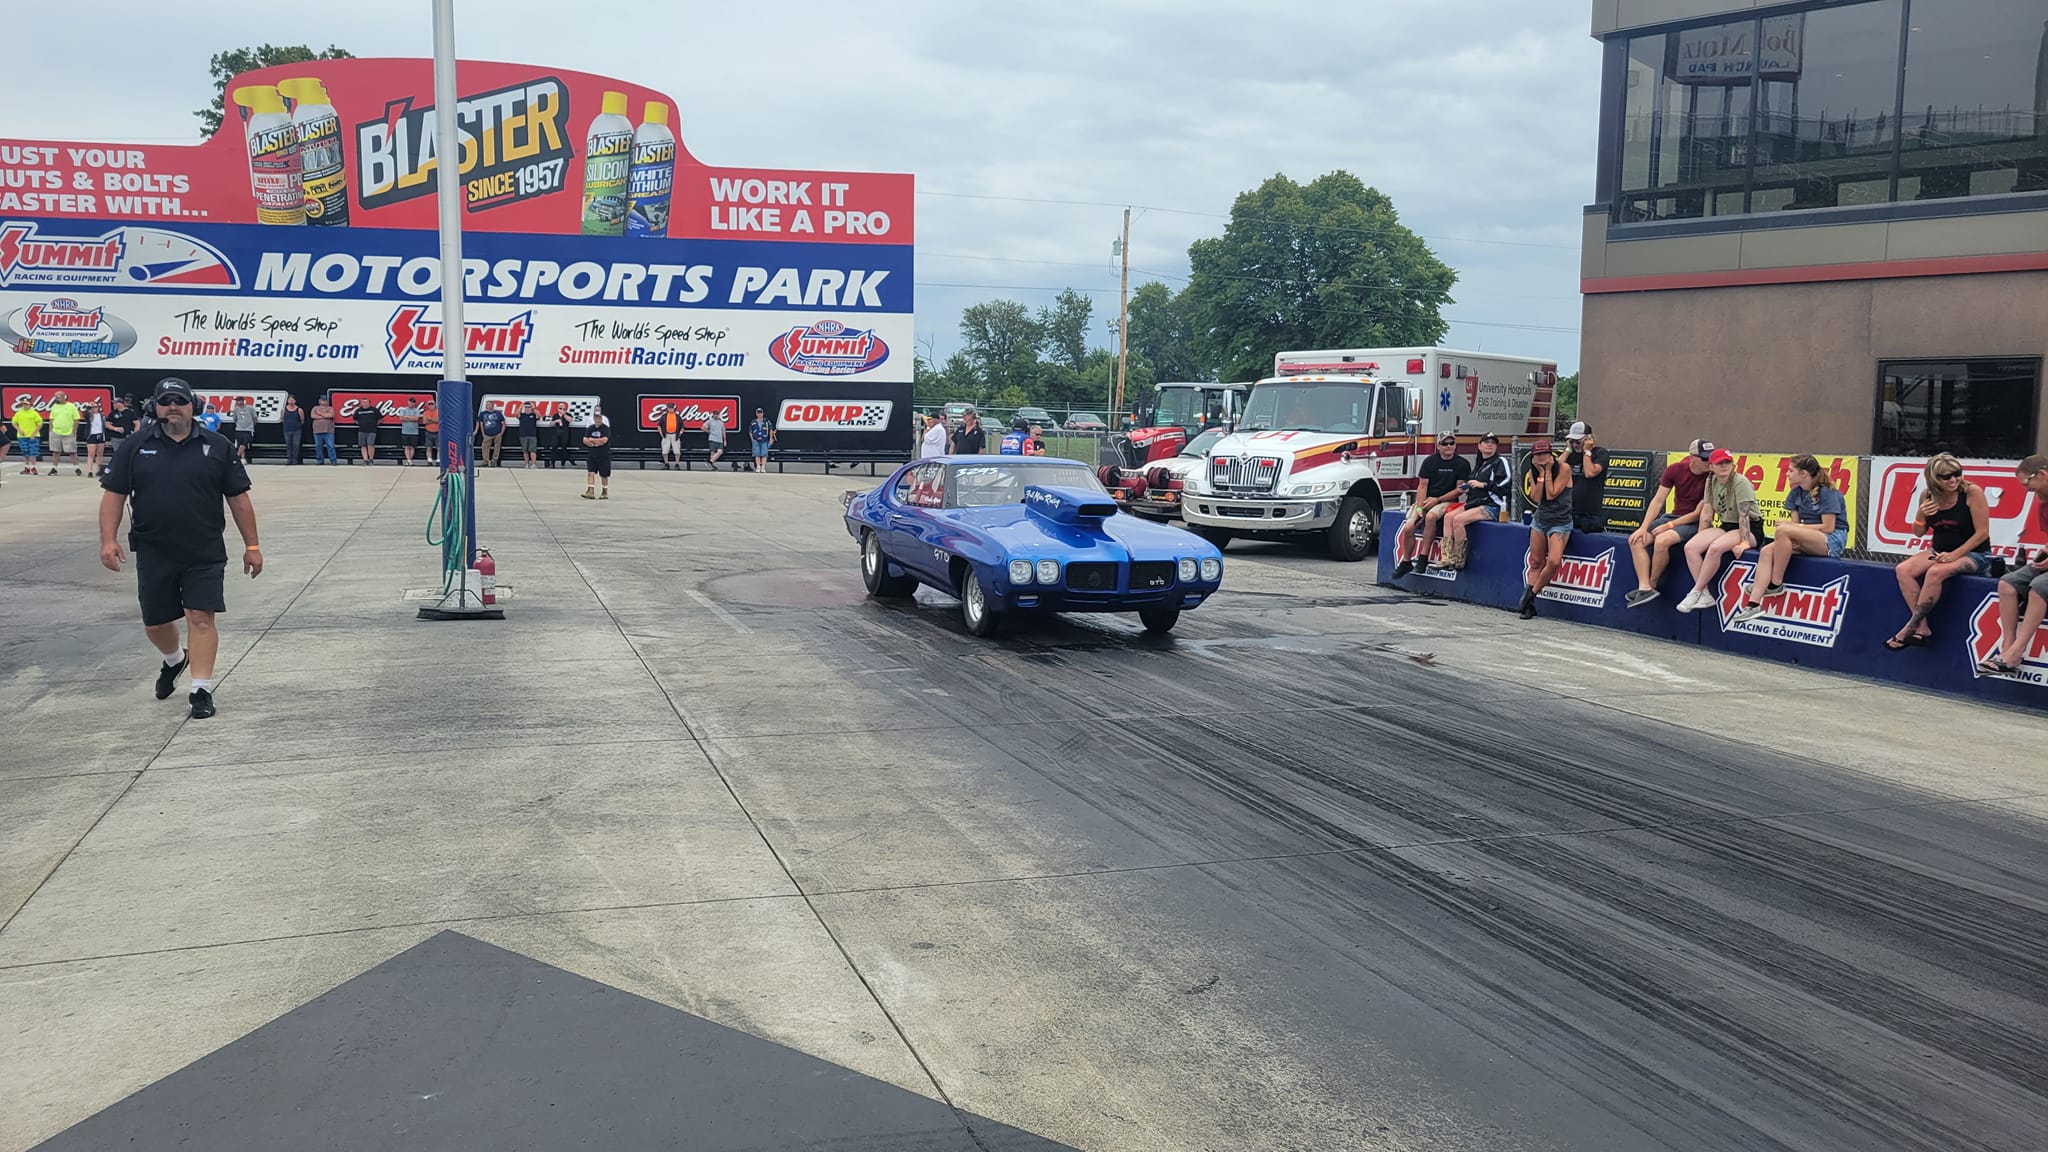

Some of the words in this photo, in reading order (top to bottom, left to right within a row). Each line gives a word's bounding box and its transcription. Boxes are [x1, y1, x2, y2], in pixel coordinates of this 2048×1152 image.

[0, 146, 58, 166] UST
[67, 149, 146, 169] YOUR
[468, 171, 515, 202] SINCE
[515, 158, 564, 195] 1957
[586, 160, 629, 181] SILICON
[630, 166, 672, 182] WHITE
[72, 171, 95, 190] &
[103, 173, 190, 193] BOLTS
[629, 176, 672, 193] LITHIUM
[709, 177, 812, 206] WORK
[821, 183, 849, 206] IT
[0, 192, 97, 213] ASTER
[711, 206, 781, 232] LIKE
[790, 210, 815, 232] A
[824, 210, 890, 236] PRO
[14, 273, 54, 281] RACING
[57, 274, 117, 283] EQUIPMENT
[253, 252, 714, 303] MOTORSPORTS
[728, 265, 890, 307] PARK
[175, 309, 207, 333] The
[214, 310, 256, 331] World's
[260, 315, 300, 338] Speed
[304, 317, 339, 339] Shop
[391, 309, 526, 359] SUMIT
[575, 319, 606, 342] The
[611, 320, 651, 341] World's
[654, 324, 692, 348] Speed
[695, 327, 727, 347] Shop
[815, 321, 842, 333] NHRA
[33, 339, 68, 358] Drag
[70, 339, 119, 359] Racing
[157, 335, 359, 362] SummitRacing.com
[559, 345, 745, 370] SummitRacing.com
[407, 360, 443, 369] RACIN
[464, 362, 522, 370] QUIPMENT
[1479, 382, 1507, 397] University
[1507, 384, 1532, 397] Hospitals
[1478, 397, 1490, 408] EMS
[784, 404, 864, 423] COMP
[1609, 458, 1645, 468] UPPORT
[1605, 478, 1643, 488] ELIVERY
[1603, 498, 1643, 508] FACTION
[1559, 592, 1603, 606] EQUIPMENT
[1733, 621, 1769, 634] RACING
[1772, 626, 1833, 645] EQUIPMENT
